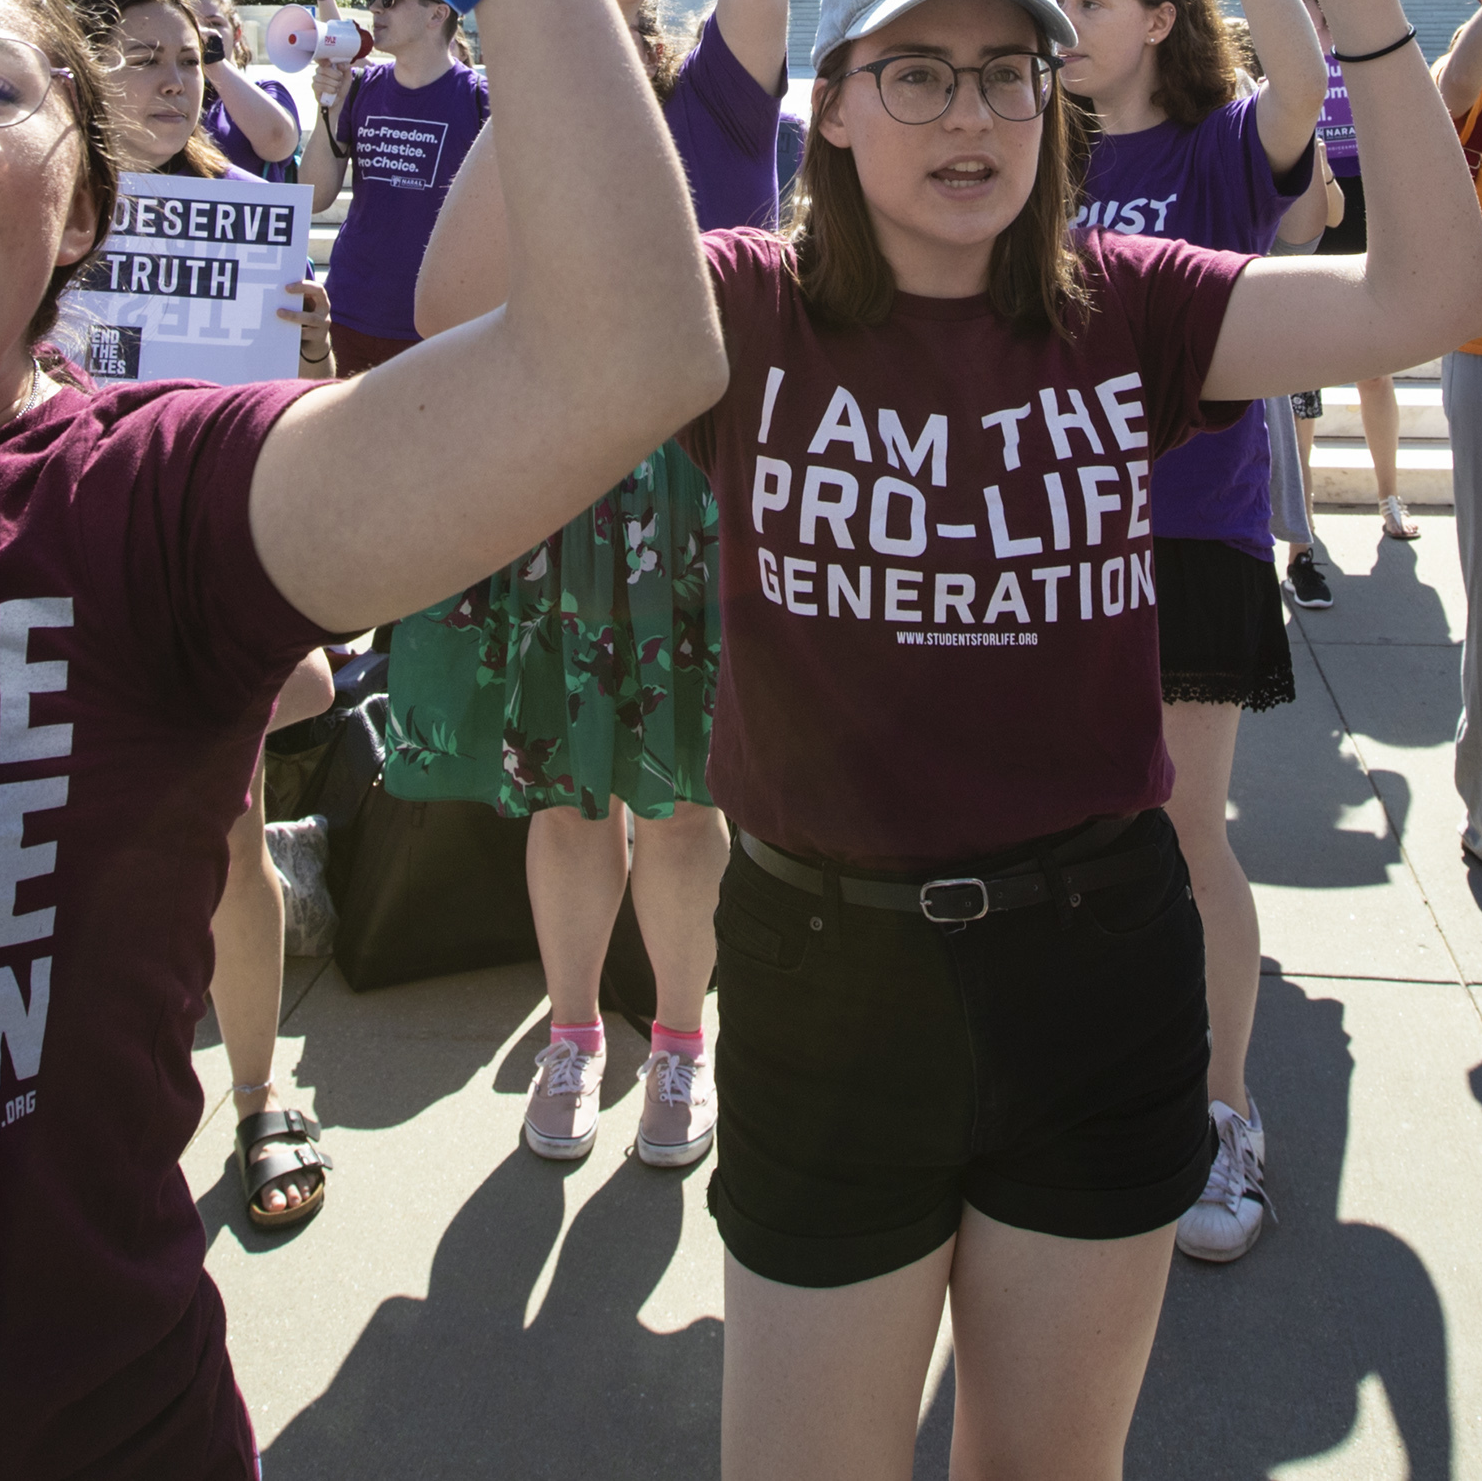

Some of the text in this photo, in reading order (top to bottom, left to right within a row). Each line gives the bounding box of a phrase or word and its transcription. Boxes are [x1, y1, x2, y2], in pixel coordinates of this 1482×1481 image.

[357, 126, 439, 144] Pro-Freedom.
[1325, 126, 1357, 137] NARA
[356, 141, 427, 158] Pro-Justice.
[113, 196, 291, 243] DESERVE
[105, 254, 234, 298] TRUTH
[91, 327, 121, 345] END
[91, 345, 119, 359] THE
[757, 366, 1149, 488] I AM THE
[751, 454, 1151, 559] PRO-LIFE
[757, 546, 1157, 624] GENERATION
[896, 630, 1039, 647] WWW.STUDENTSFORLIFE.ORG
